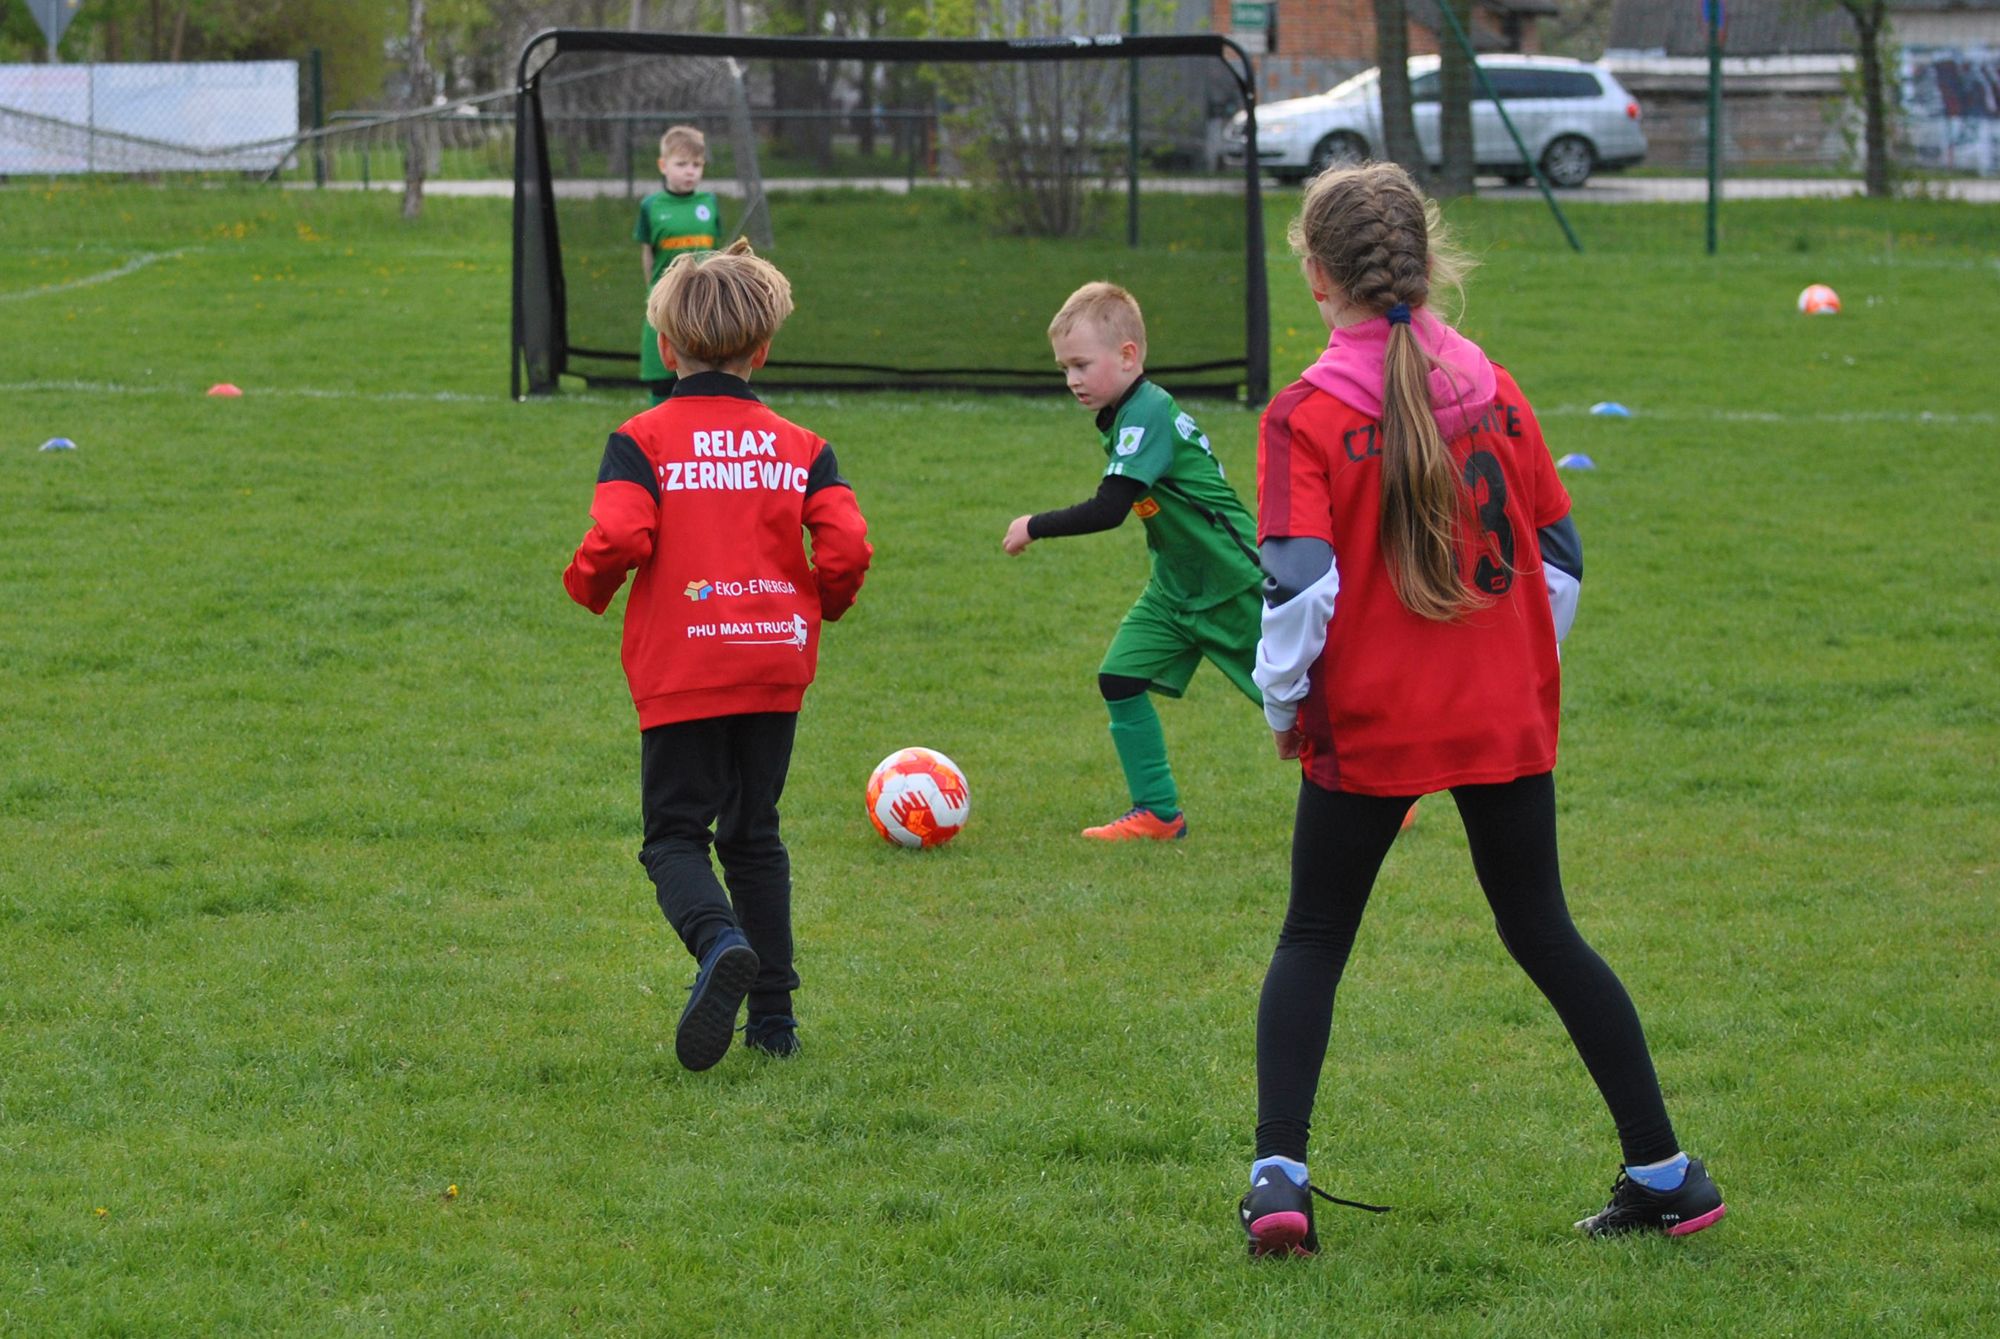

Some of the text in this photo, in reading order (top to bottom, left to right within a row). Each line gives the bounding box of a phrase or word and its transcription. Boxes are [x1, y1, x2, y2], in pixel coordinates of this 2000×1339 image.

[693, 430, 777, 457] RELAX
[1453, 450, 1515, 595] 3
[715, 579, 797, 596] EKO-ENERGIA
[687, 621, 796, 638] PHU MAXI TRUCK
